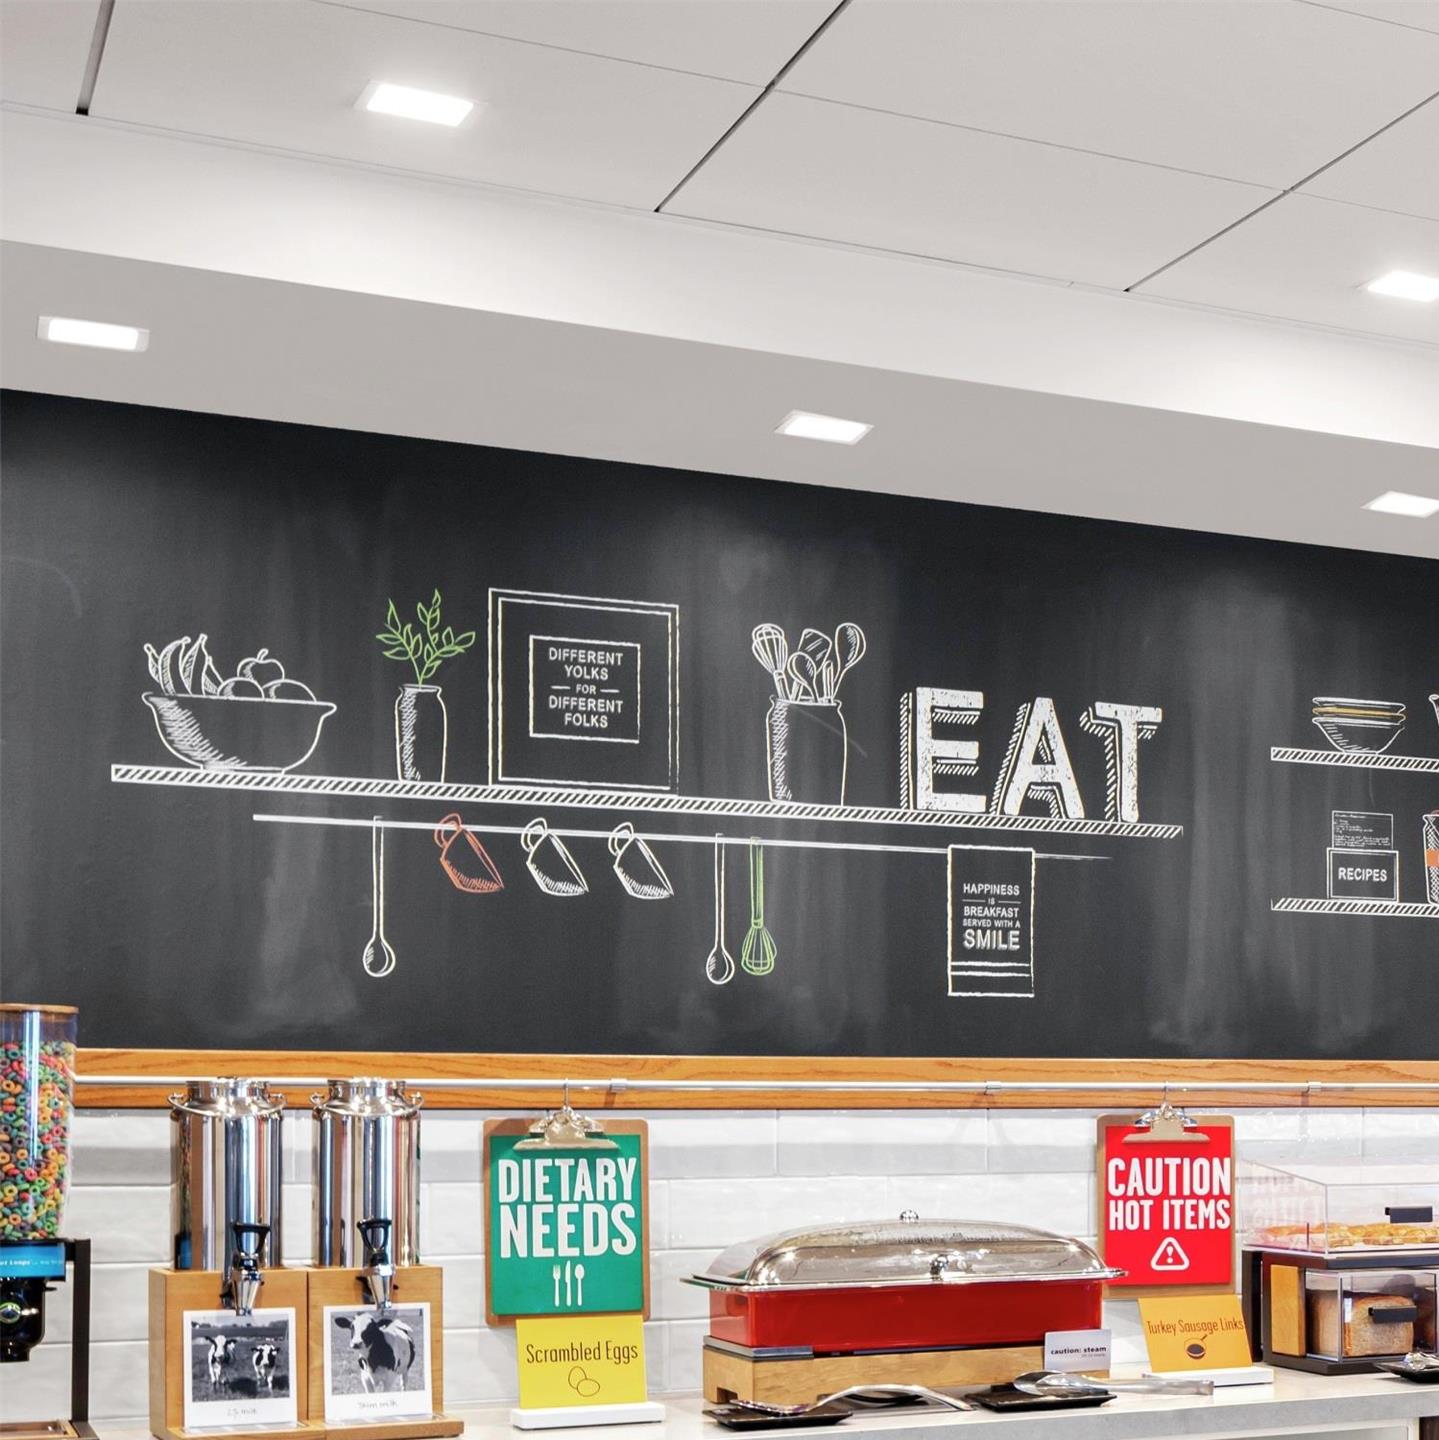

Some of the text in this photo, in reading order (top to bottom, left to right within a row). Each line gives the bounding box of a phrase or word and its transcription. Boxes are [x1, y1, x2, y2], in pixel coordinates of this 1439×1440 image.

[548, 647, 623, 666] DIFFERENT
[564, 664, 608, 680] YOLKS
[575, 683, 596, 695] FOR
[548, 695, 623, 713] DIFFERENT
[564, 712, 608, 728] FOLKS
[900, 686, 1162, 823] EAT
[1338, 867, 1388, 882] RECIPES
[963, 883, 1020, 896] HAPPINESS
[987, 897, 996, 905] IS
[963, 906, 1019, 918] BREAKFAST
[962, 918, 1021, 928] SERVED WITH A
[962, 929, 1020, 951] SMILE
[498, 1157, 637, 1203] DIETARY
[1107, 1157, 1231, 1197] CAUTION
[1109, 1199, 1154, 1231] HOT
[1162, 1199, 1231, 1231] ITEMS
[500, 1202, 637, 1259] NEEDS
[1147, 1317, 1244, 1336] Turkey Sausage Links
[526, 1340, 638, 1365] Scrambled Eggs
